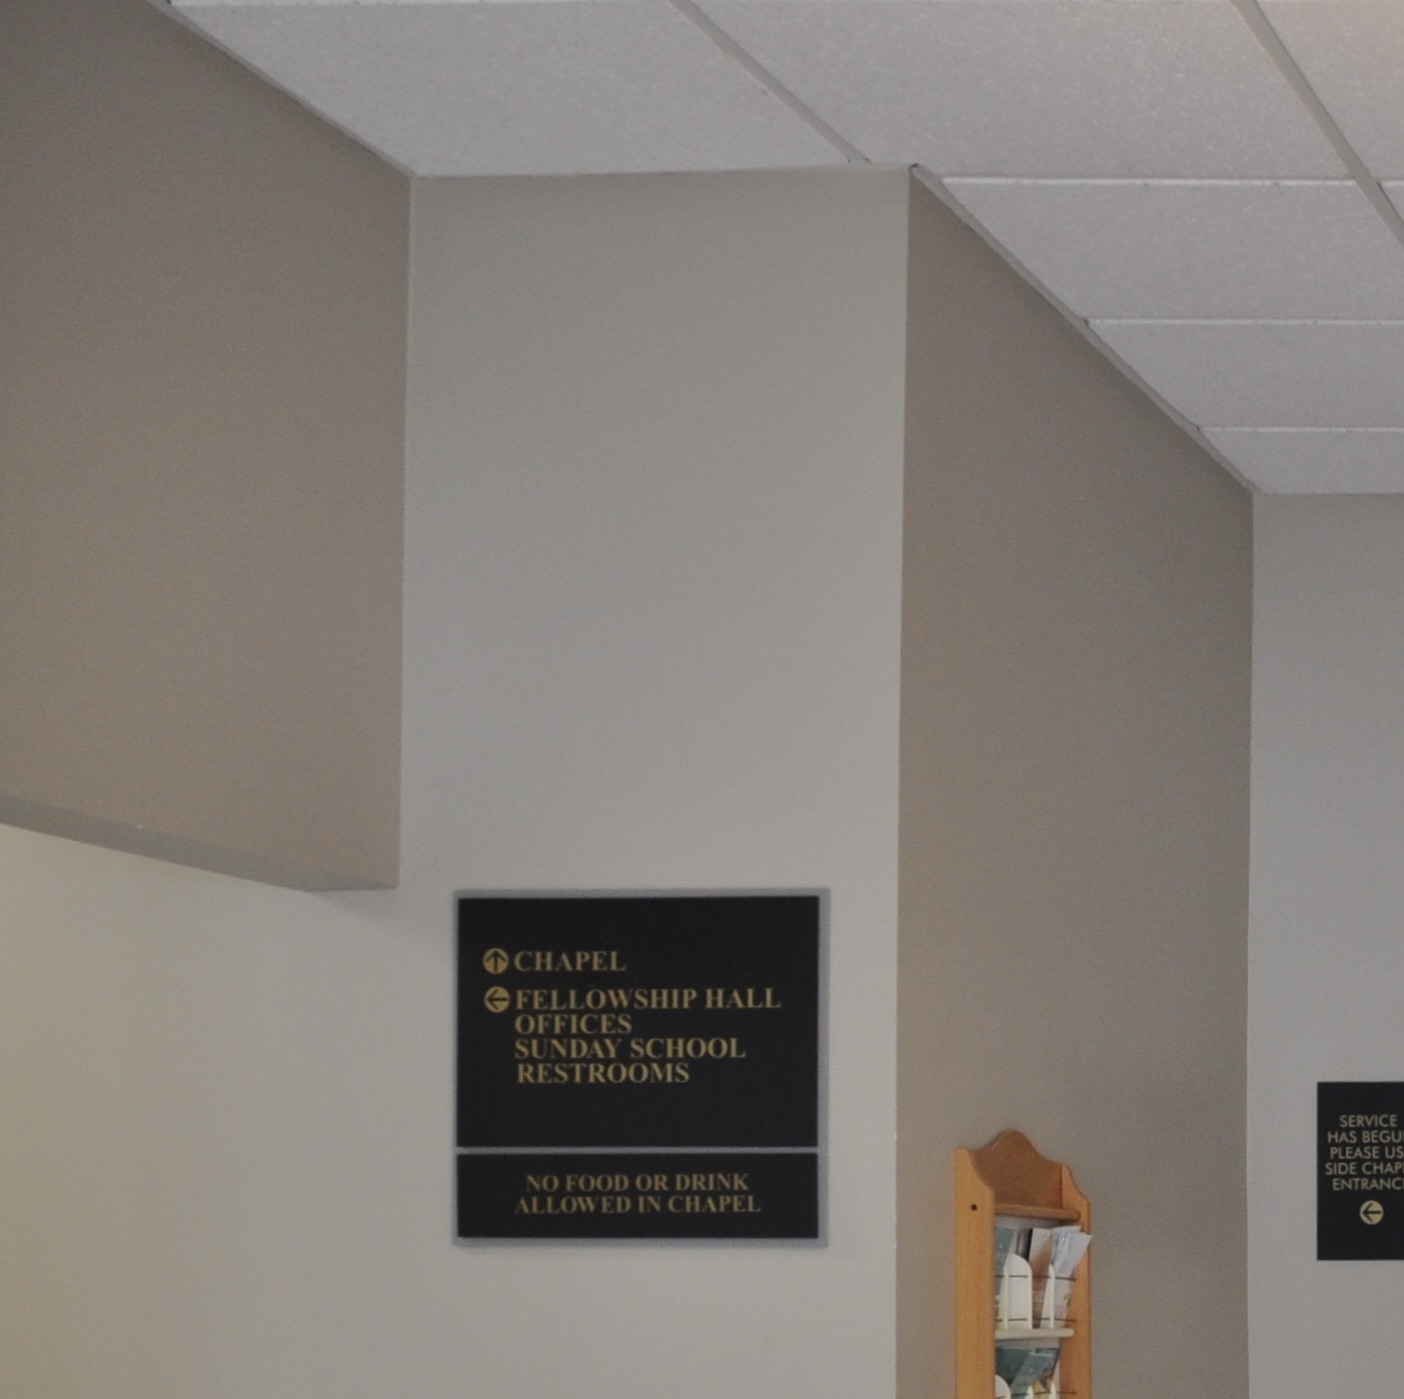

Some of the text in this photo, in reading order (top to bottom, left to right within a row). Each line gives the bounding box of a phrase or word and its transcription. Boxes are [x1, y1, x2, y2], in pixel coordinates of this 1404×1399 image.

[513, 951, 627, 972] CHAPEL
[515, 987, 782, 1010] FELLOWSHIP HALL
[514, 1014, 632, 1035] OFFICES
[514, 1037, 746, 1059] SUNDAY SCHOOL
[517, 1063, 690, 1084] RESTROOMS
[1339, 1114, 1398, 1128] SERVICE
[1327, 1131, 1357, 1144] HAS
[1330, 1146, 1380, 1160] PLEASE
[1325, 1162, 1357, 1175] SIDE
[526, 1173, 750, 1192] NO FOOD OR DRINK
[514, 1195, 761, 1214] ALLOWED IN CHAPEL
